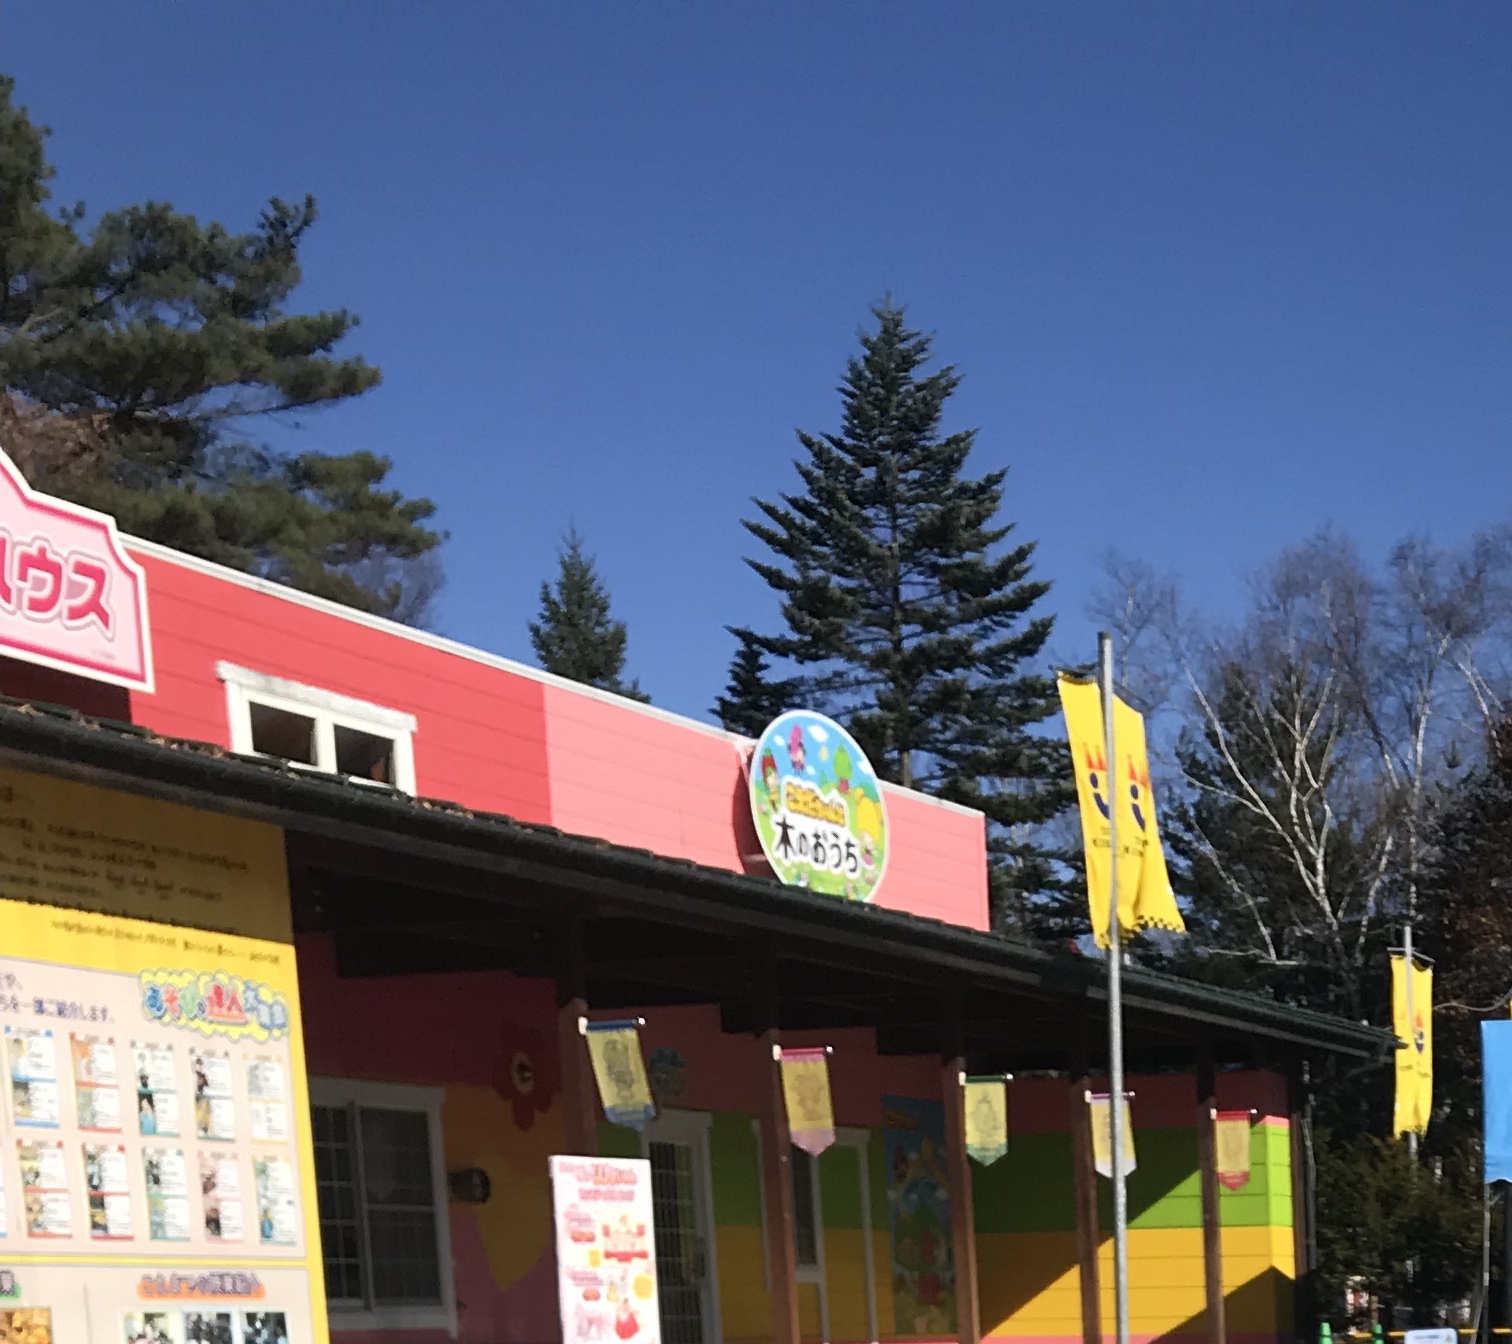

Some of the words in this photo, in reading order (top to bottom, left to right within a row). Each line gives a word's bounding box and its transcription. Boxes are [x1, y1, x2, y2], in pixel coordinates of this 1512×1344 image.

[775, 816, 859, 874] 木のおうち
